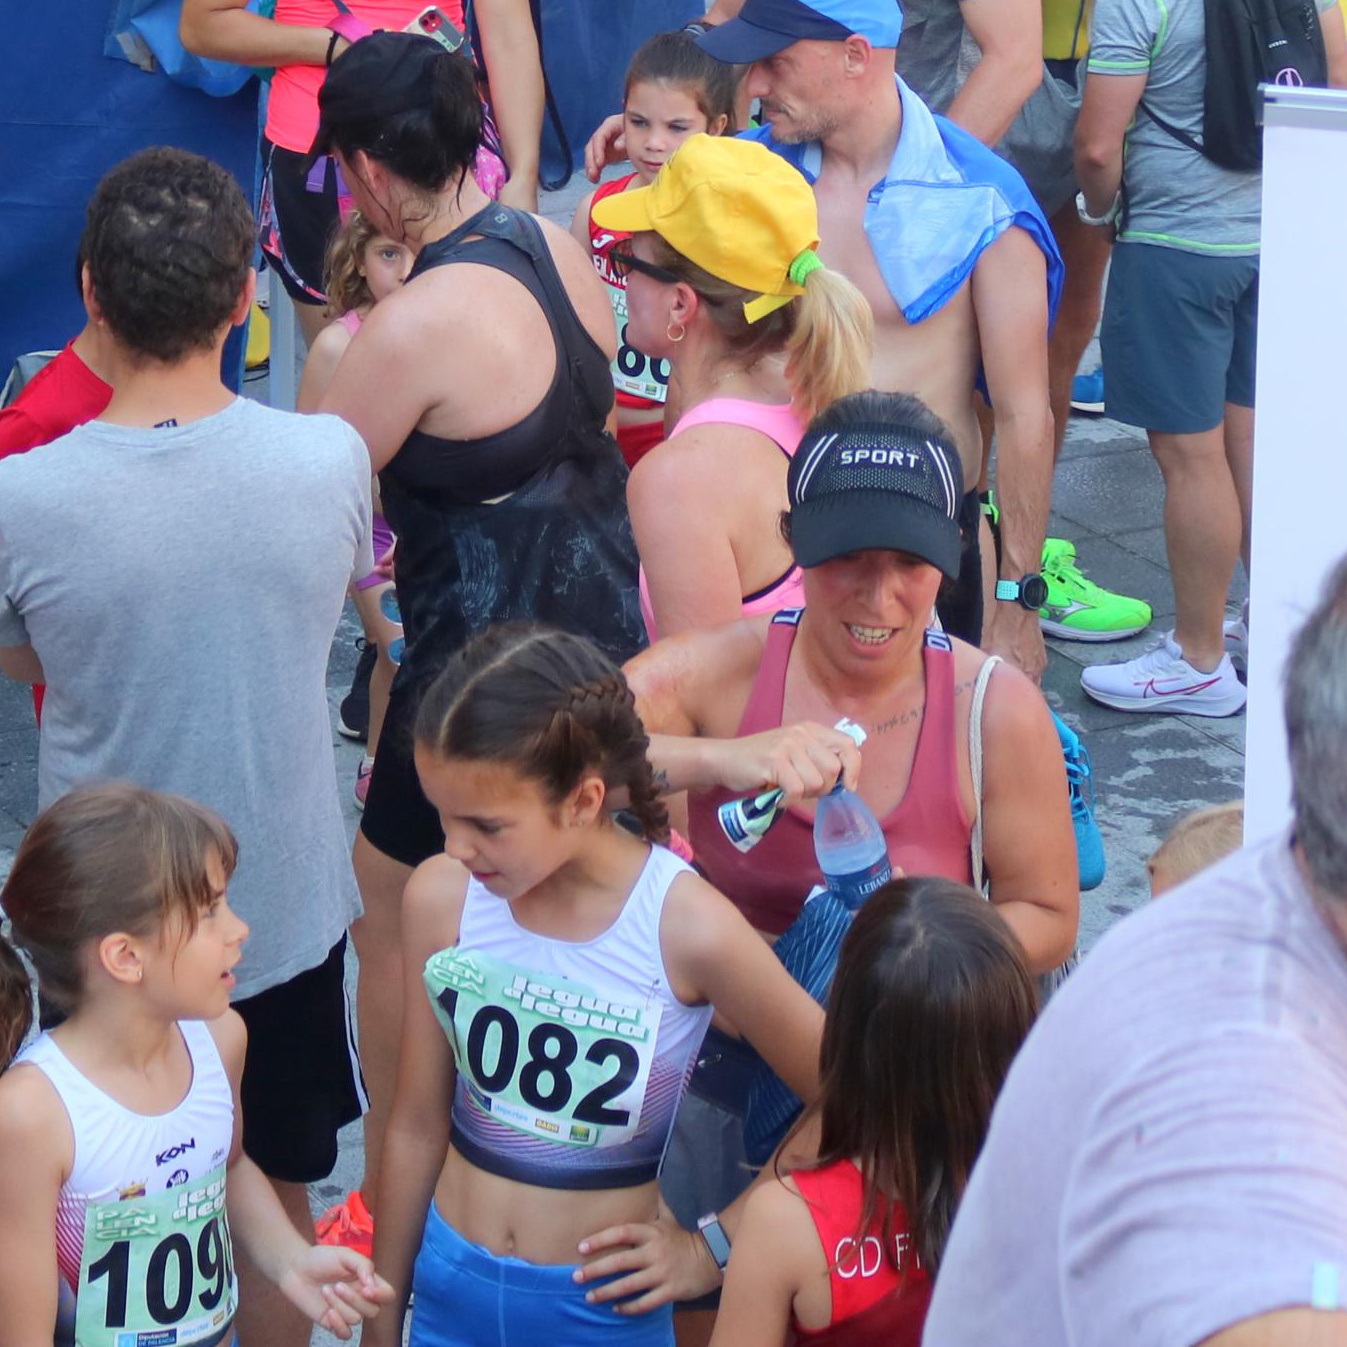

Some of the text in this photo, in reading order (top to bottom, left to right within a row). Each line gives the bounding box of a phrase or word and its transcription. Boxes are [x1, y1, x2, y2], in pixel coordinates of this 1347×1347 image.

[839, 449, 921, 469] SPORT
[512, 975, 640, 1021] legua
[436, 987, 640, 1127] 1082
[835, 1236, 882, 1279] CD
